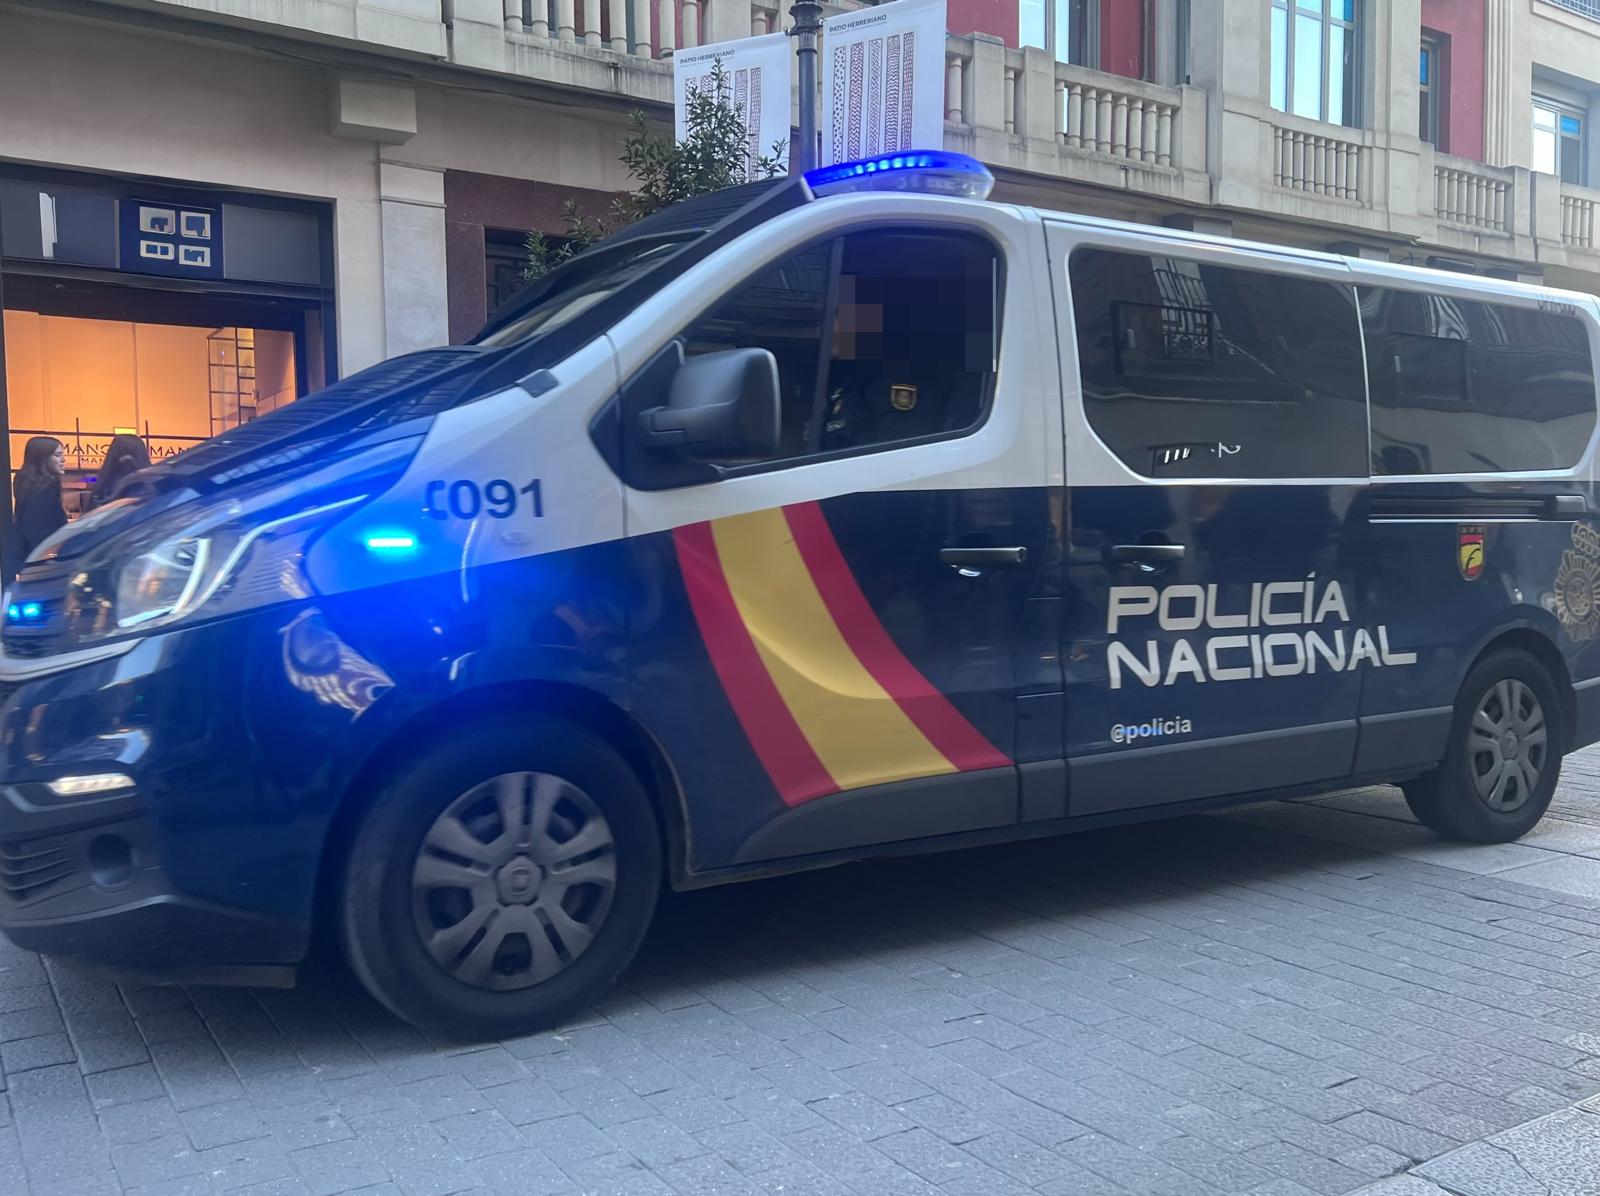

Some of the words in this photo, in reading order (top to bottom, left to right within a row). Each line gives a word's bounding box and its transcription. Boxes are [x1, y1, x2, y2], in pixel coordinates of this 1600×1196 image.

[829, 23, 847, 33] PATIO
[847, 14, 887, 29] HERRERIANO
[680, 56, 697, 64] PATIO
[1107, 571, 1350, 634] POLICÍA
[1107, 625, 1417, 689] NACIONAL
[1111, 716, 1192, 743] @policia
